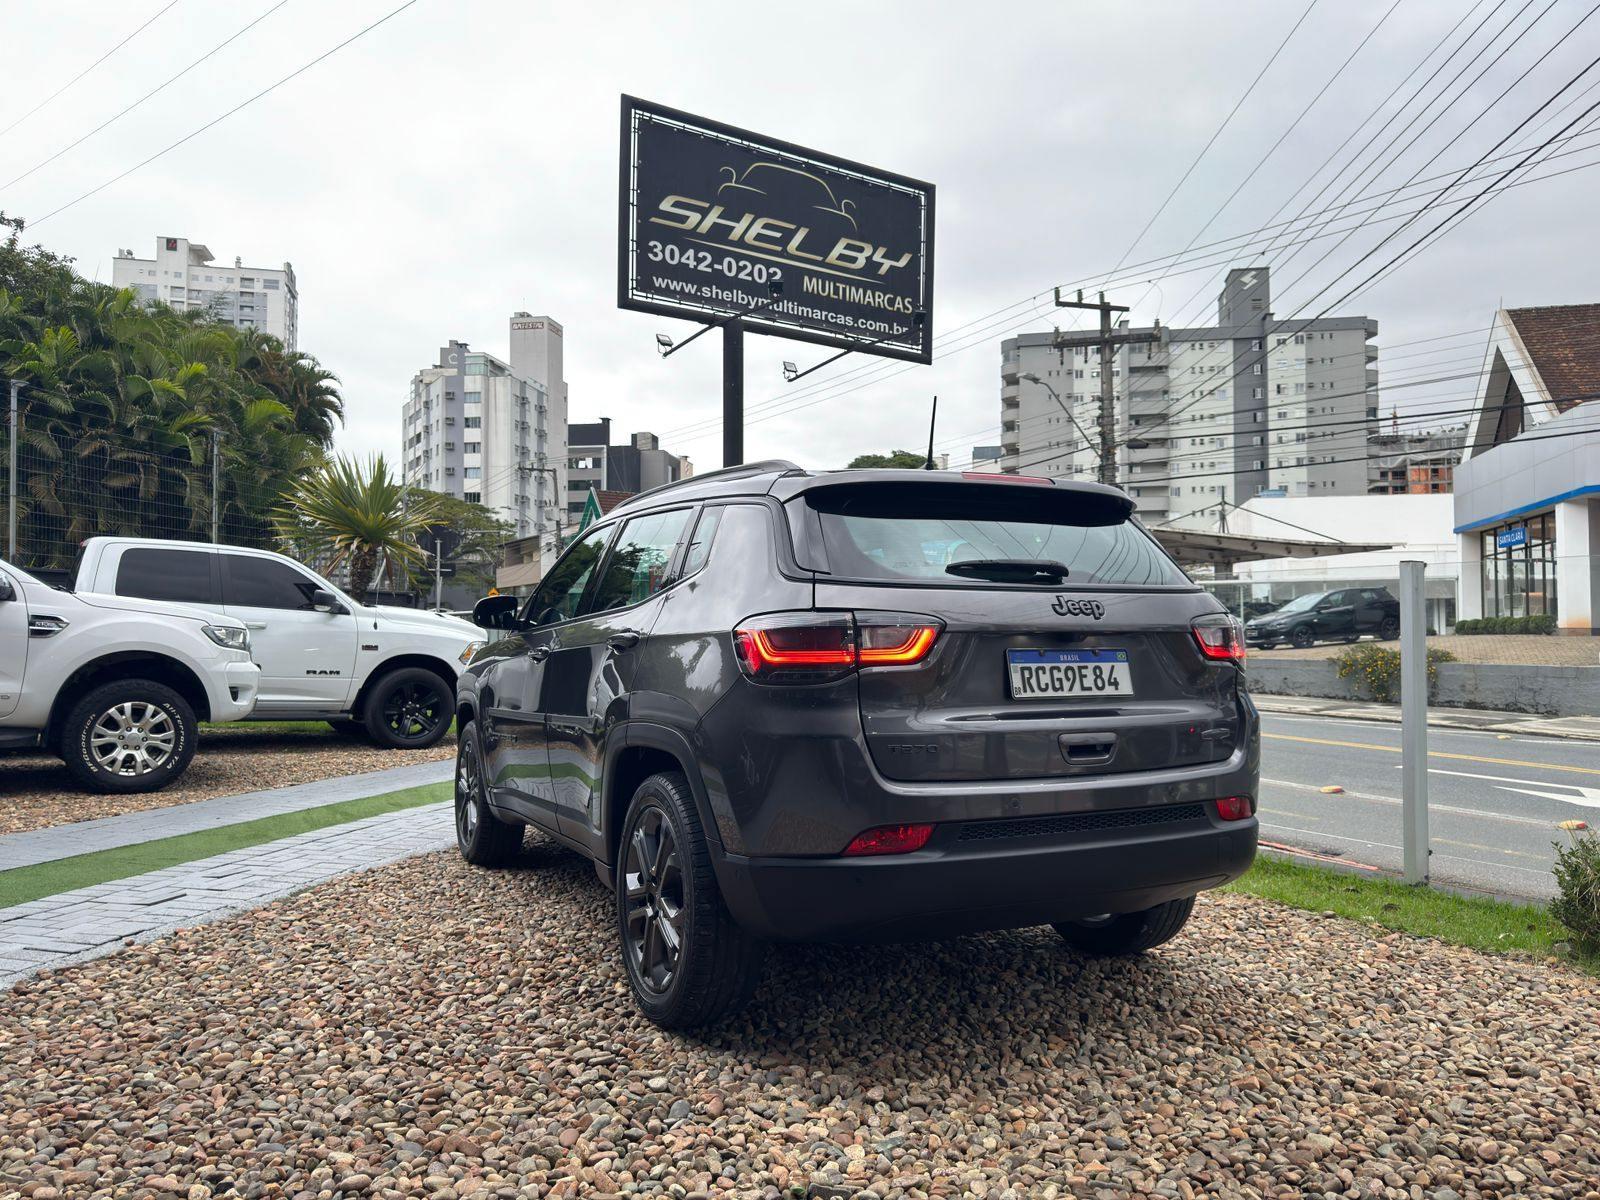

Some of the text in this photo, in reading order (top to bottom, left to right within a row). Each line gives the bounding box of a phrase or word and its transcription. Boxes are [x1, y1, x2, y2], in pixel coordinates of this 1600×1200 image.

[648, 195, 913, 275] SHELBY
[648, 241, 782, 284] 3042-0202
[803, 275, 913, 314] MULTIMARCAS
[1499, 530, 1524, 545] SANTA CLARA
[1051, 595, 1105, 620] Jeep
[1014, 686, 1022, 696] BR
[1020, 665, 1119, 693] RCG9E84
